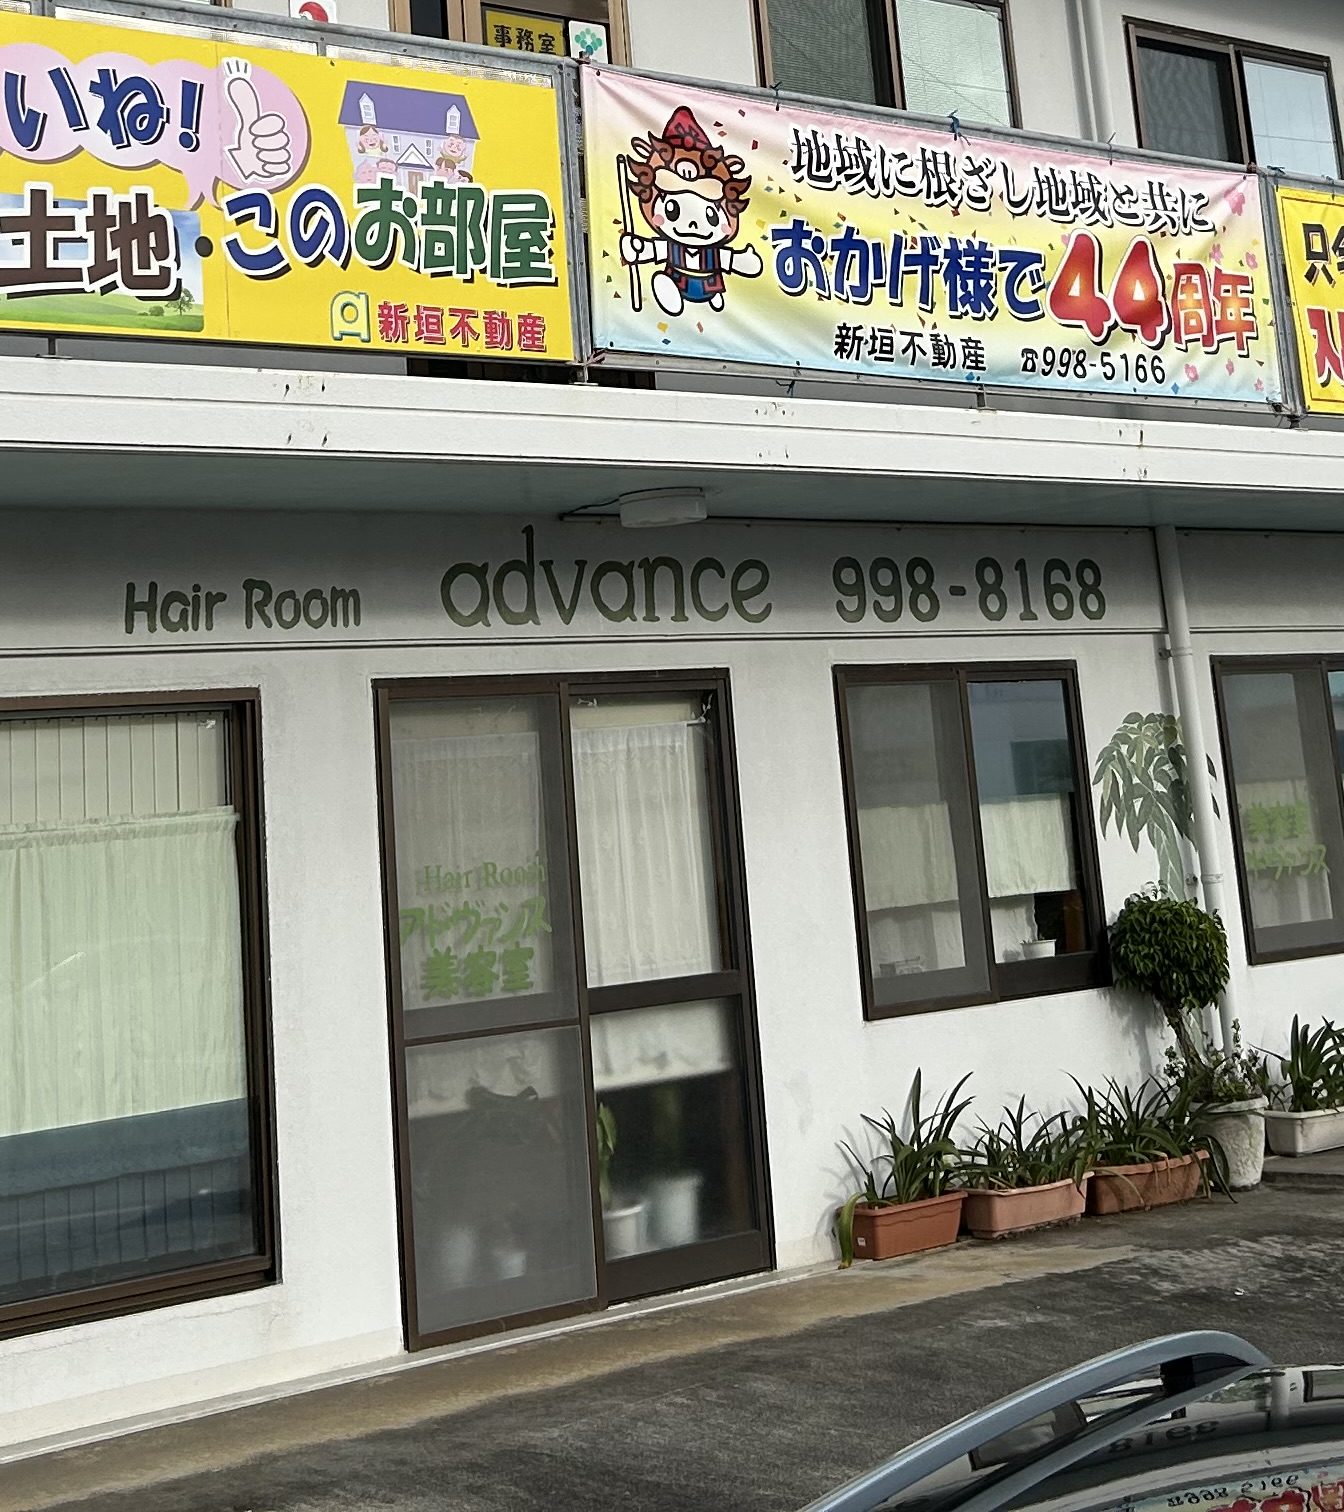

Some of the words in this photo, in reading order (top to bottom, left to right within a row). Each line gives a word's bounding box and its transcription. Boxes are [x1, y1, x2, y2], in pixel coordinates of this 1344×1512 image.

[493, 24, 557, 55] 事務室
[790, 126, 1216, 237] 地域に根ざし地域と共に
[376, 299, 549, 353] 新垣不動産
[834, 322, 987, 373] 新垣不動産
[124, 578, 224, 635] Hair
[243, 578, 364, 631] Room
[441, 524, 774, 627] advance
[831, 555, 1107, 624] 998-8168
[423, 863, 474, 892] Hair
